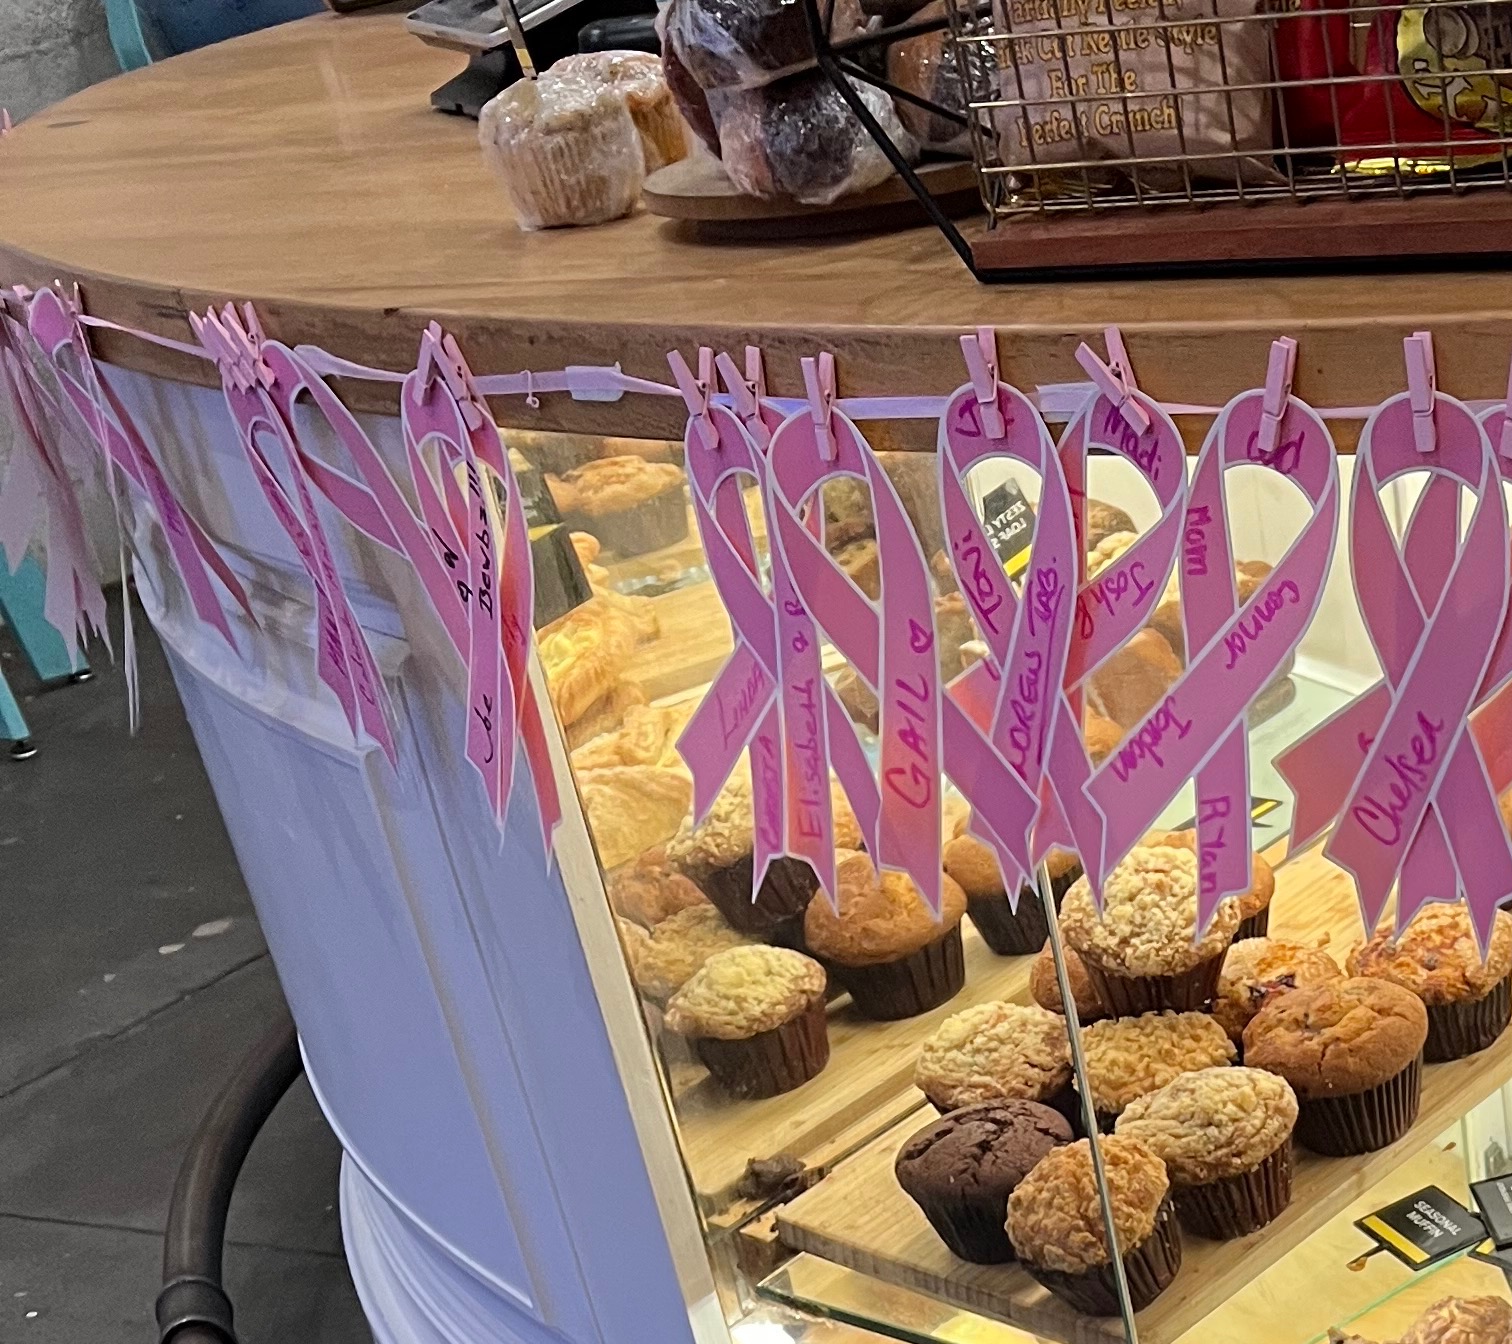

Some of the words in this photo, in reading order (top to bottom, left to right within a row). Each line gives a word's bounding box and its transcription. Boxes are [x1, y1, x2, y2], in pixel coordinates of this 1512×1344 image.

[1080, 28, 1150, 56] Ketle
[885, 672, 930, 809] GAIL
[1405, 1210, 1445, 1238] MUFFIN
[1413, 1200, 1462, 1236] SEASONAL
